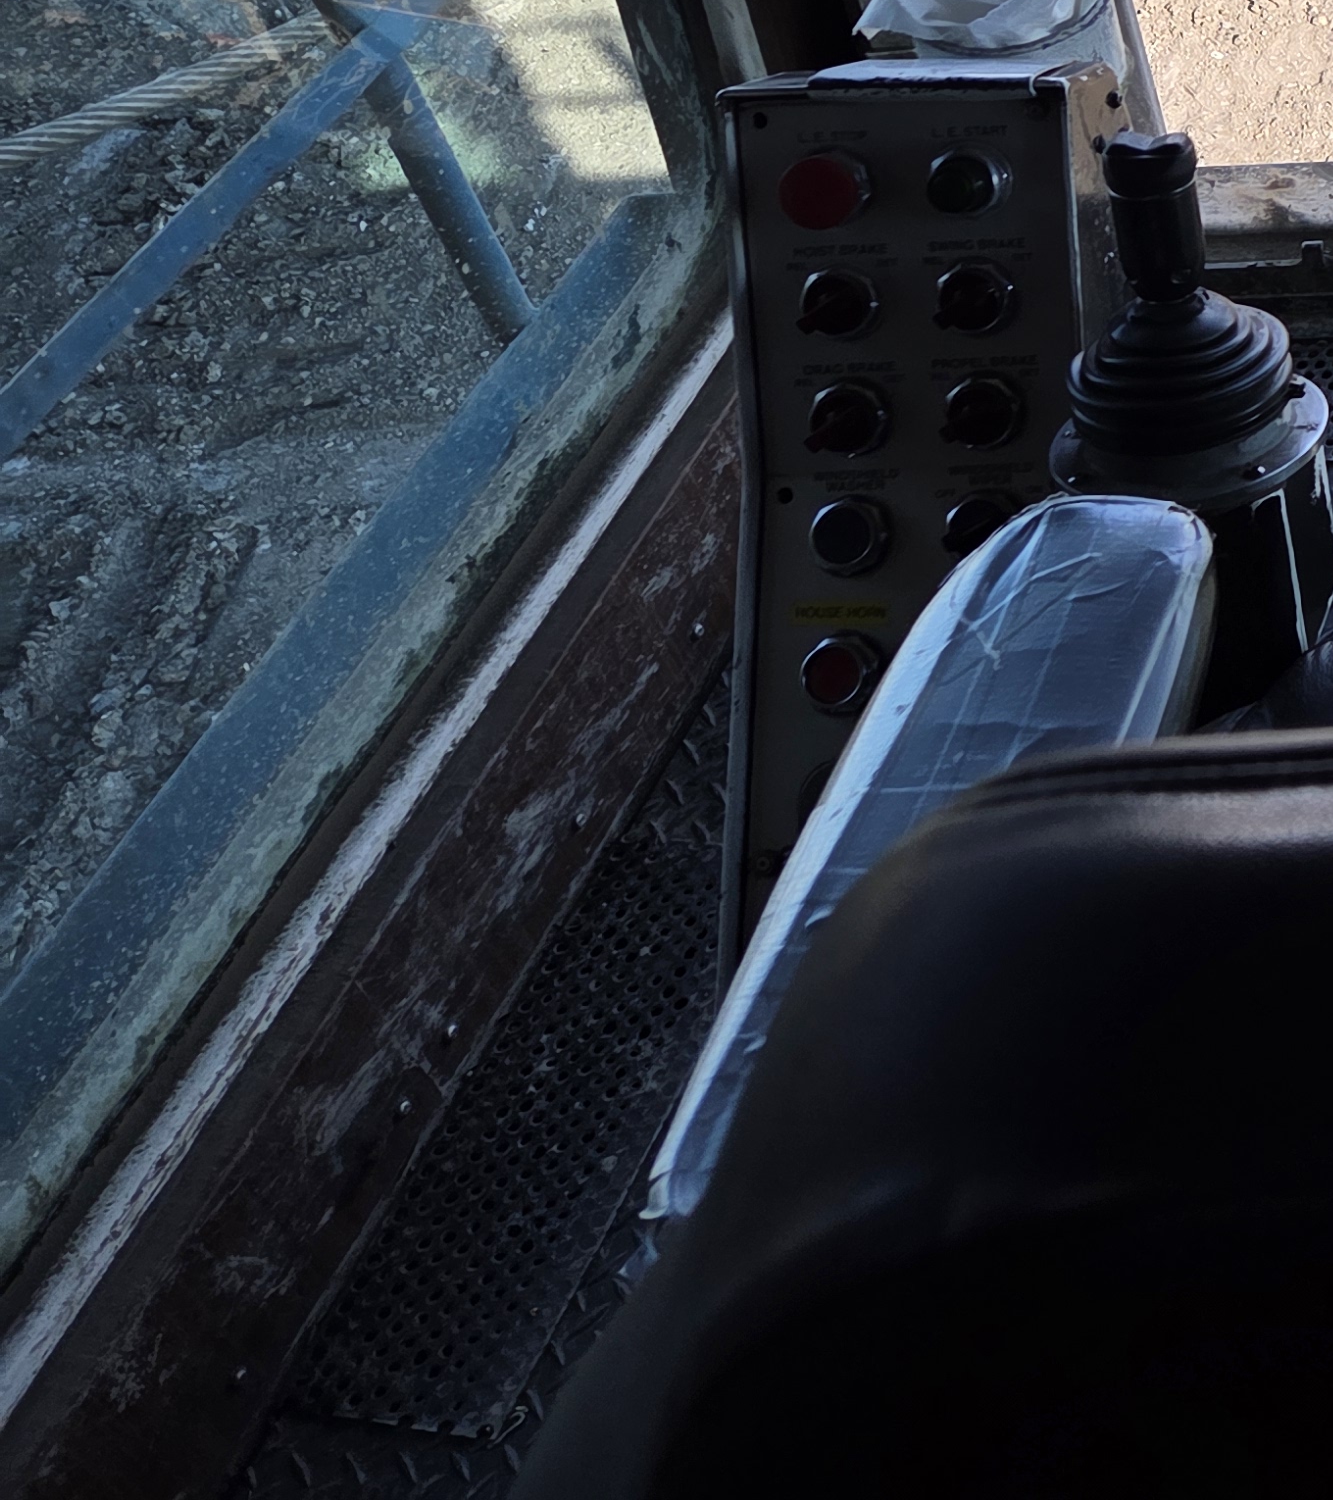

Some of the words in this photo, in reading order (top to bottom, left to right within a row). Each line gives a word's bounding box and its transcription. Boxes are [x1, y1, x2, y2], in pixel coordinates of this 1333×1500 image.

[793, 244, 835, 258] HOIST
[838, 243, 888, 256] BRAKE
[927, 239, 974, 252] SWING
[977, 237, 1025, 249] BRAKE
[803, 364, 844, 375] DRAG
[847, 361, 896, 373] BRAKE
[931, 358, 986, 369] PROPEL
[990, 354, 1038, 366] BRAKE
[846, 605, 886, 618] HORN
